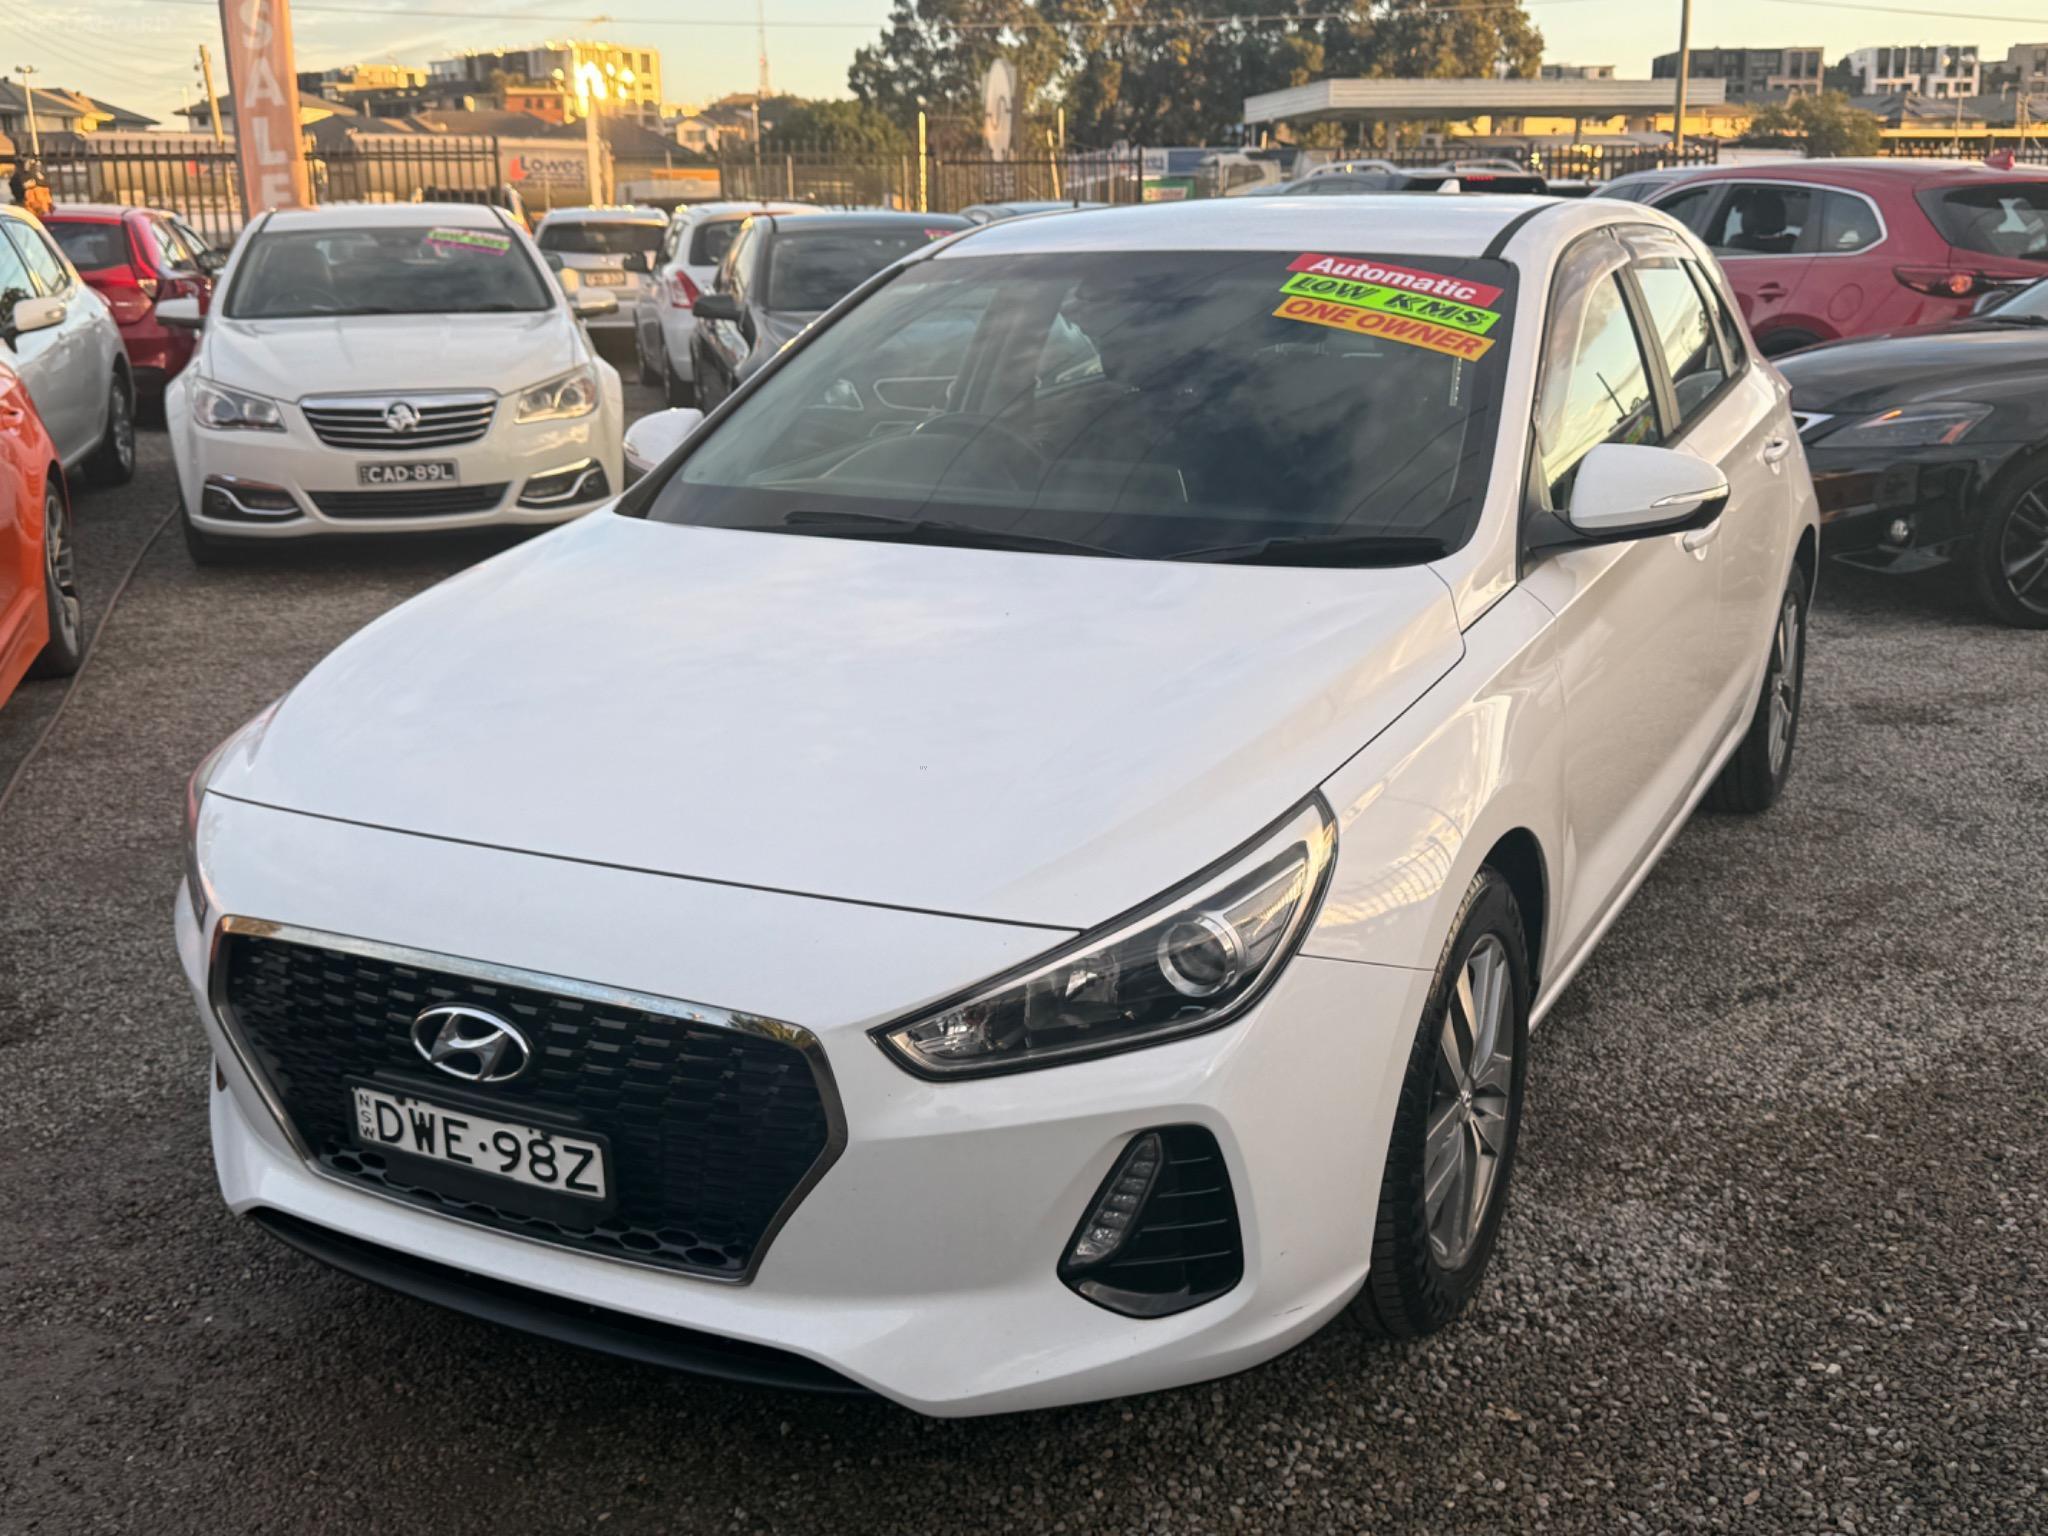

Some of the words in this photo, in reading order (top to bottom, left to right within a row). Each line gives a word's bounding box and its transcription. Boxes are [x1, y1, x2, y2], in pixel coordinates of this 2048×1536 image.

[238, 0, 293, 207] SALE
[1289, 276, 1380, 299] LOW
[1384, 294, 1489, 326] KMS
[1308, 257, 1477, 300] Automatic
[1285, 300, 1357, 322] ONE
[1356, 313, 1483, 355] OWNER
[359, 1093, 375, 1139] NSW
